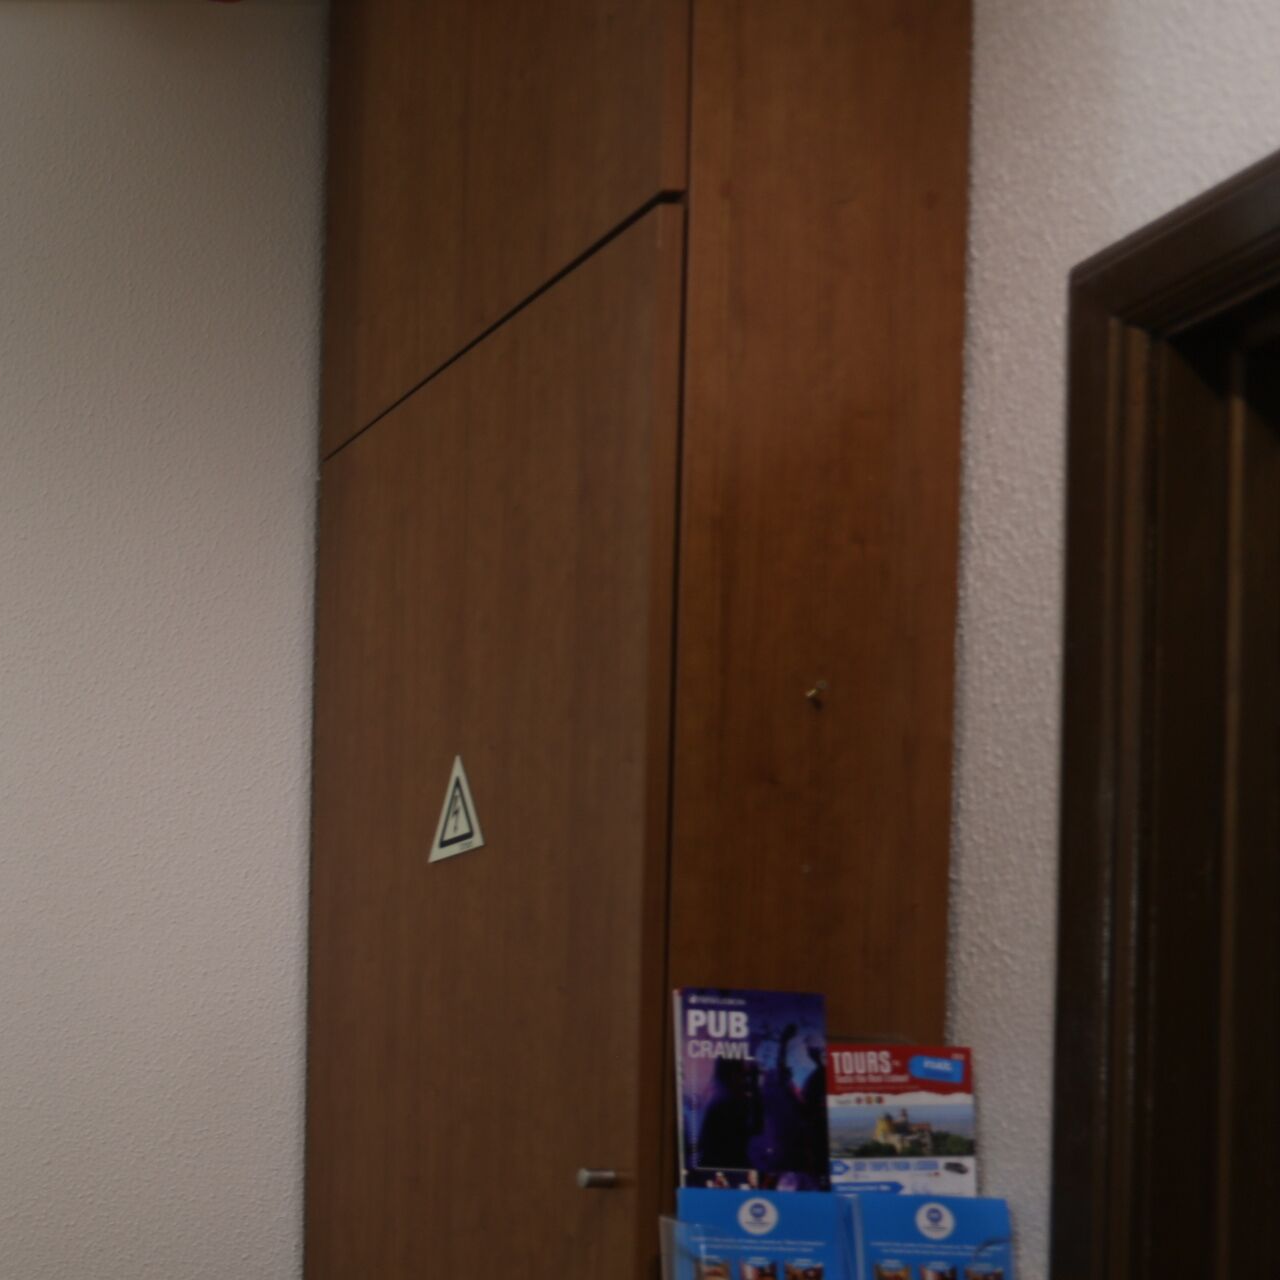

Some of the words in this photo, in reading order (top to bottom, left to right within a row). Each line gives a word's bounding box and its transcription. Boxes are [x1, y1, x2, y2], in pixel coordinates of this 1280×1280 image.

[687, 1008, 749, 1039] PUB
[688, 1039, 754, 1061] CRAWL
[831, 1050, 894, 1075] TOURS
